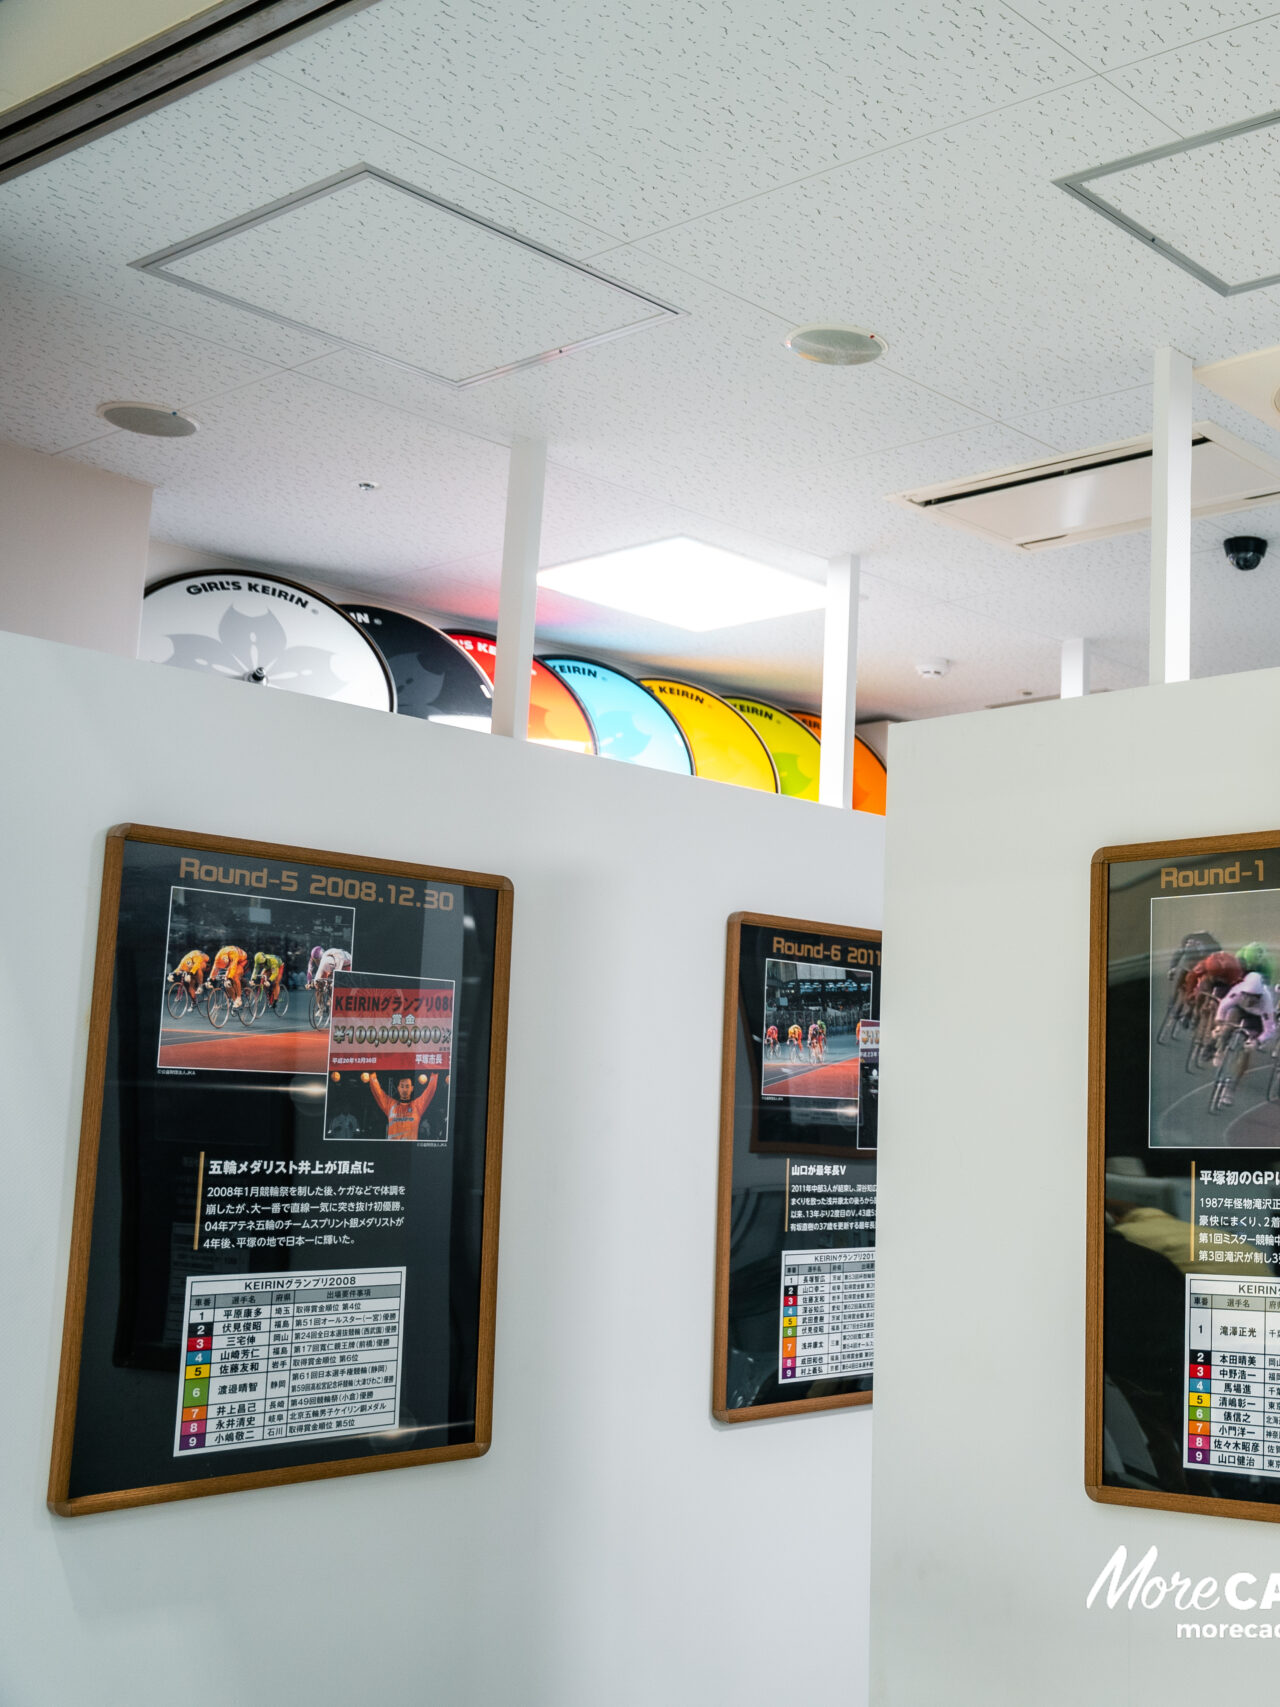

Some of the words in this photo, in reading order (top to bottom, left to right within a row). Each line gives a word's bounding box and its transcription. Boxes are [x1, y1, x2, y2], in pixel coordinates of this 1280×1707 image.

[186, 581, 242, 595] GIRL'S
[248, 582, 309, 609] KEIRIN
[659, 686, 704, 704] KEIRIN
[1160, 860, 1264, 889] Round-1
[179, 857, 299, 892] Round-5
[310, 874, 454, 911] 2008.12.30
[772, 936, 841, 961] Round-6
[847, 947, 881, 966] 2011
[208, 1160, 374, 1175] 五輪メダリスト井上が頂点に
[244, 1276, 356, 1291] KEIRINグランプリ2008
[199, 1312, 204, 1320] 1
[197, 1325, 205, 1335] 2
[1198, 1325, 1203, 1334] 1
[1219, 1326, 1257, 1338] 滝澤正光
[196, 1339, 204, 1349] 3
[226, 1335, 256, 1346] 三宅伸
[195, 1353, 203, 1362] 4
[1197, 1352, 1204, 1362] 2
[194, 1367, 202, 1376] 5
[1197, 1366, 1204, 1376] 3
[1219, 1368, 1256, 1380] 中野浩一
[1196, 1380, 1204, 1391] 4
[192, 1388, 200, 1397] 6
[1196, 1395, 1203, 1404] 5
[191, 1408, 199, 1418] 7
[1196, 1408, 1203, 1419] 6
[190, 1423, 198, 1433] 8
[1196, 1423, 1203, 1432] 7
[1218, 1425, 1256, 1437] 小門洋一
[189, 1437, 197, 1446] 9
[1195, 1437, 1203, 1447] 8
[1195, 1451, 1202, 1461] 9
